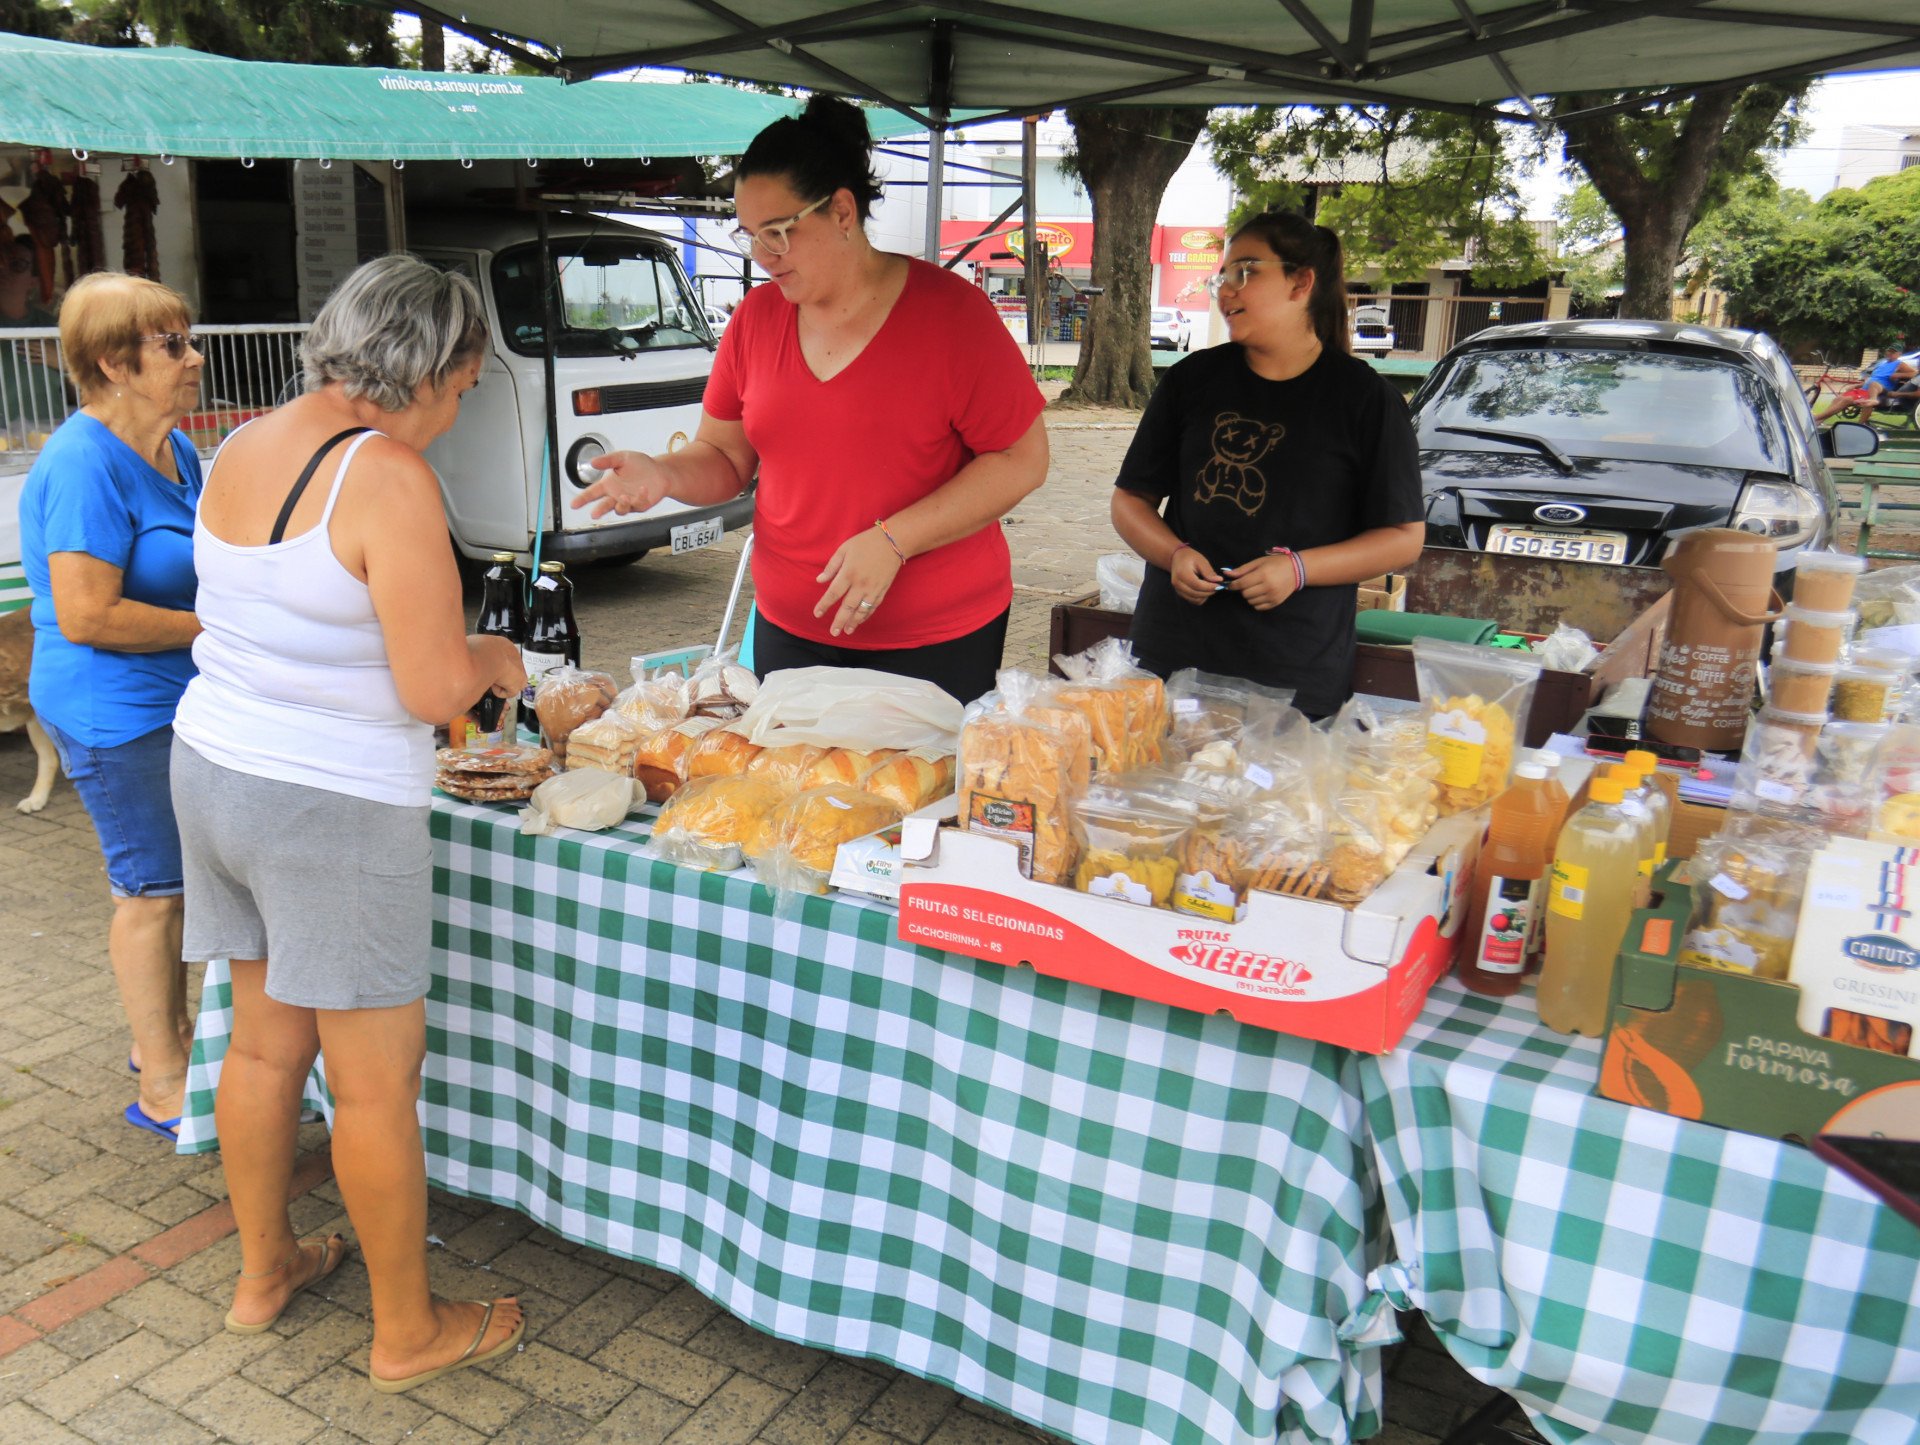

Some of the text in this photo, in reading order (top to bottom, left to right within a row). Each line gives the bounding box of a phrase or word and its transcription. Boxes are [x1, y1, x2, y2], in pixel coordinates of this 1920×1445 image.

[1010, 229, 1072, 244] Trarato
[1169, 252, 1187, 263] TELE
[1547, 508, 1572, 519] Ford
[1692, 651, 1731, 664] COFFEE
[1690, 669, 1726, 684] COFFEE
[1681, 705, 1715, 720] Coffee
[907, 896, 1065, 941] FRUTAS SELECIONADAS
[907, 923, 981, 949] CACHOEIRINHA
[990, 942, 1003, 953] RS
[1177, 929, 1231, 943] FRUTAS
[1850, 941, 1915, 965] CRITUTS
[1180, 940, 1304, 988] STEFFEN
[1833, 976, 1918, 1005] GRISSINI
[1746, 1035, 1831, 1069] PAPAYA
[1724, 1041, 1858, 1097] Formosa
